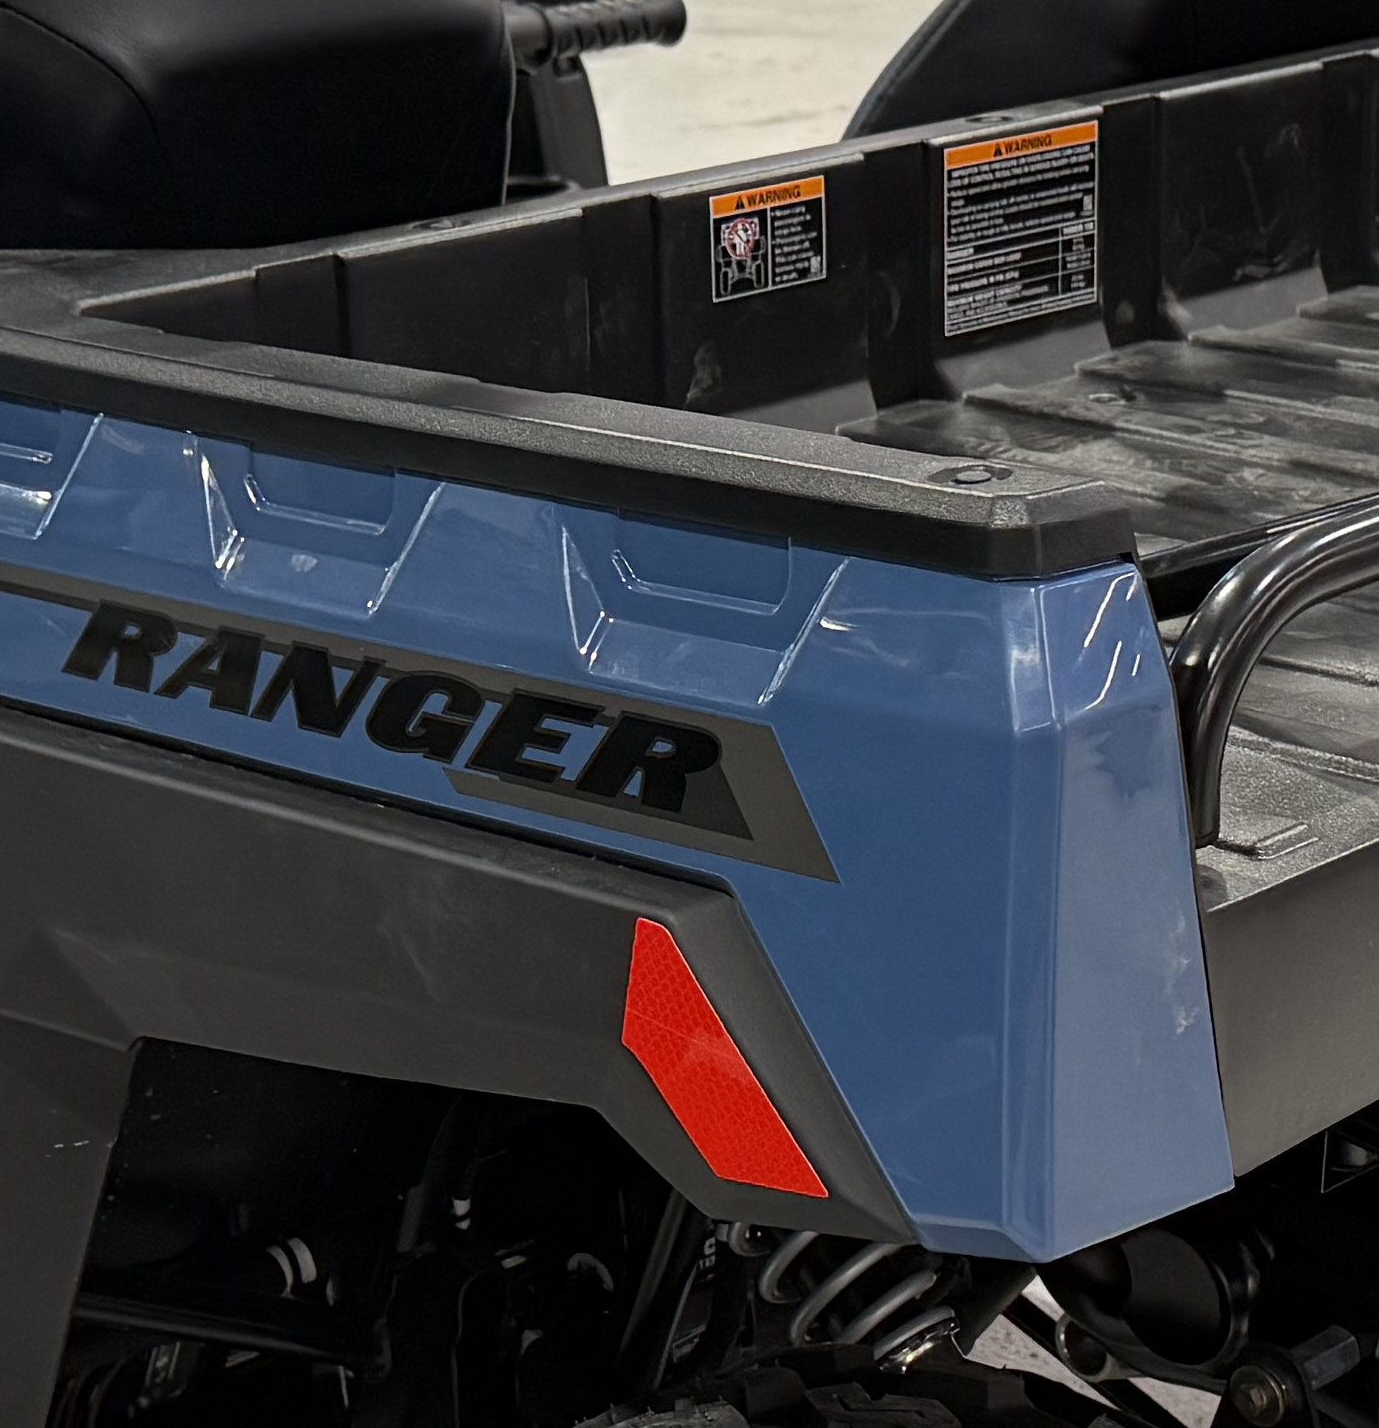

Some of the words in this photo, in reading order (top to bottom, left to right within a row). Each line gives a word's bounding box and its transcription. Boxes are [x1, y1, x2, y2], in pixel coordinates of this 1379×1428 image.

[1004, 134, 1053, 151] WARNING
[747, 185, 801, 206] WARNING
[62, 599, 723, 814] RANGER
